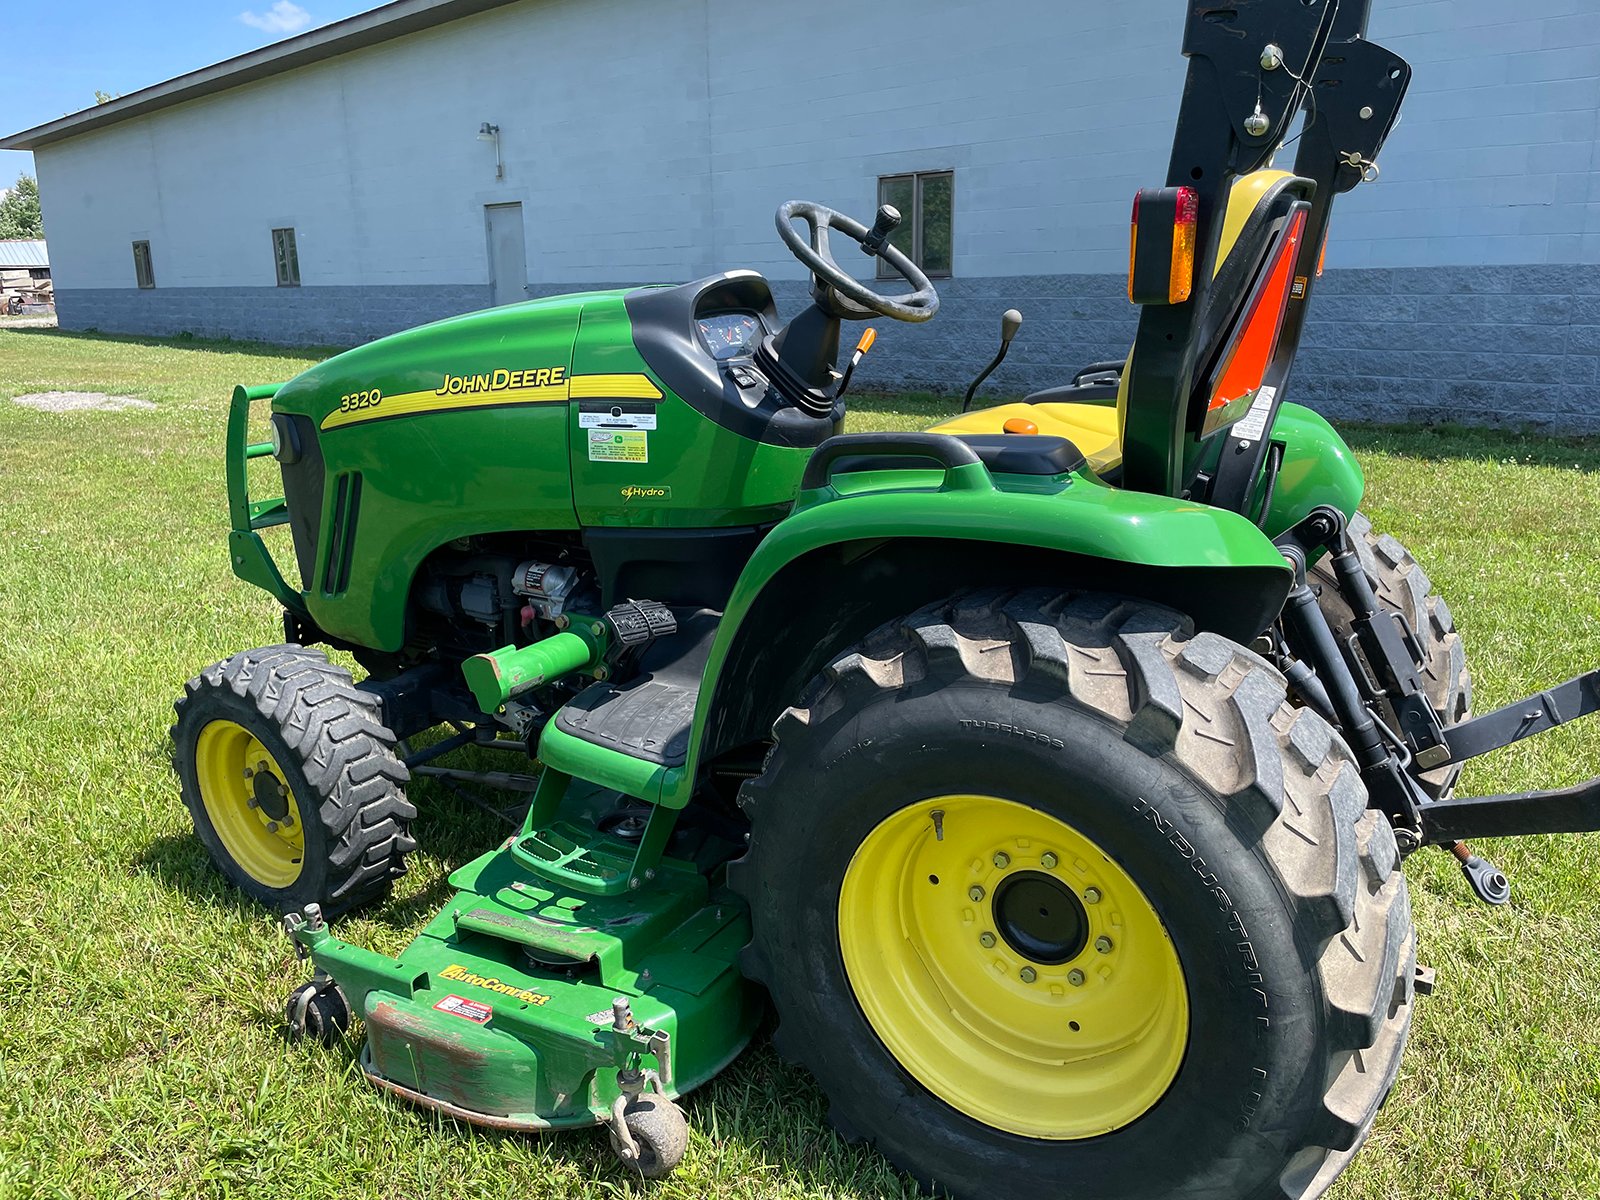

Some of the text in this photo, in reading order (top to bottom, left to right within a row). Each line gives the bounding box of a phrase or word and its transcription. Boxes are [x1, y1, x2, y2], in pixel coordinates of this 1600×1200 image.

[436, 366, 566, 396] JOHN DEERE
[340, 388, 383, 413] 3320
[439, 965, 552, 1007] AutoConnect
